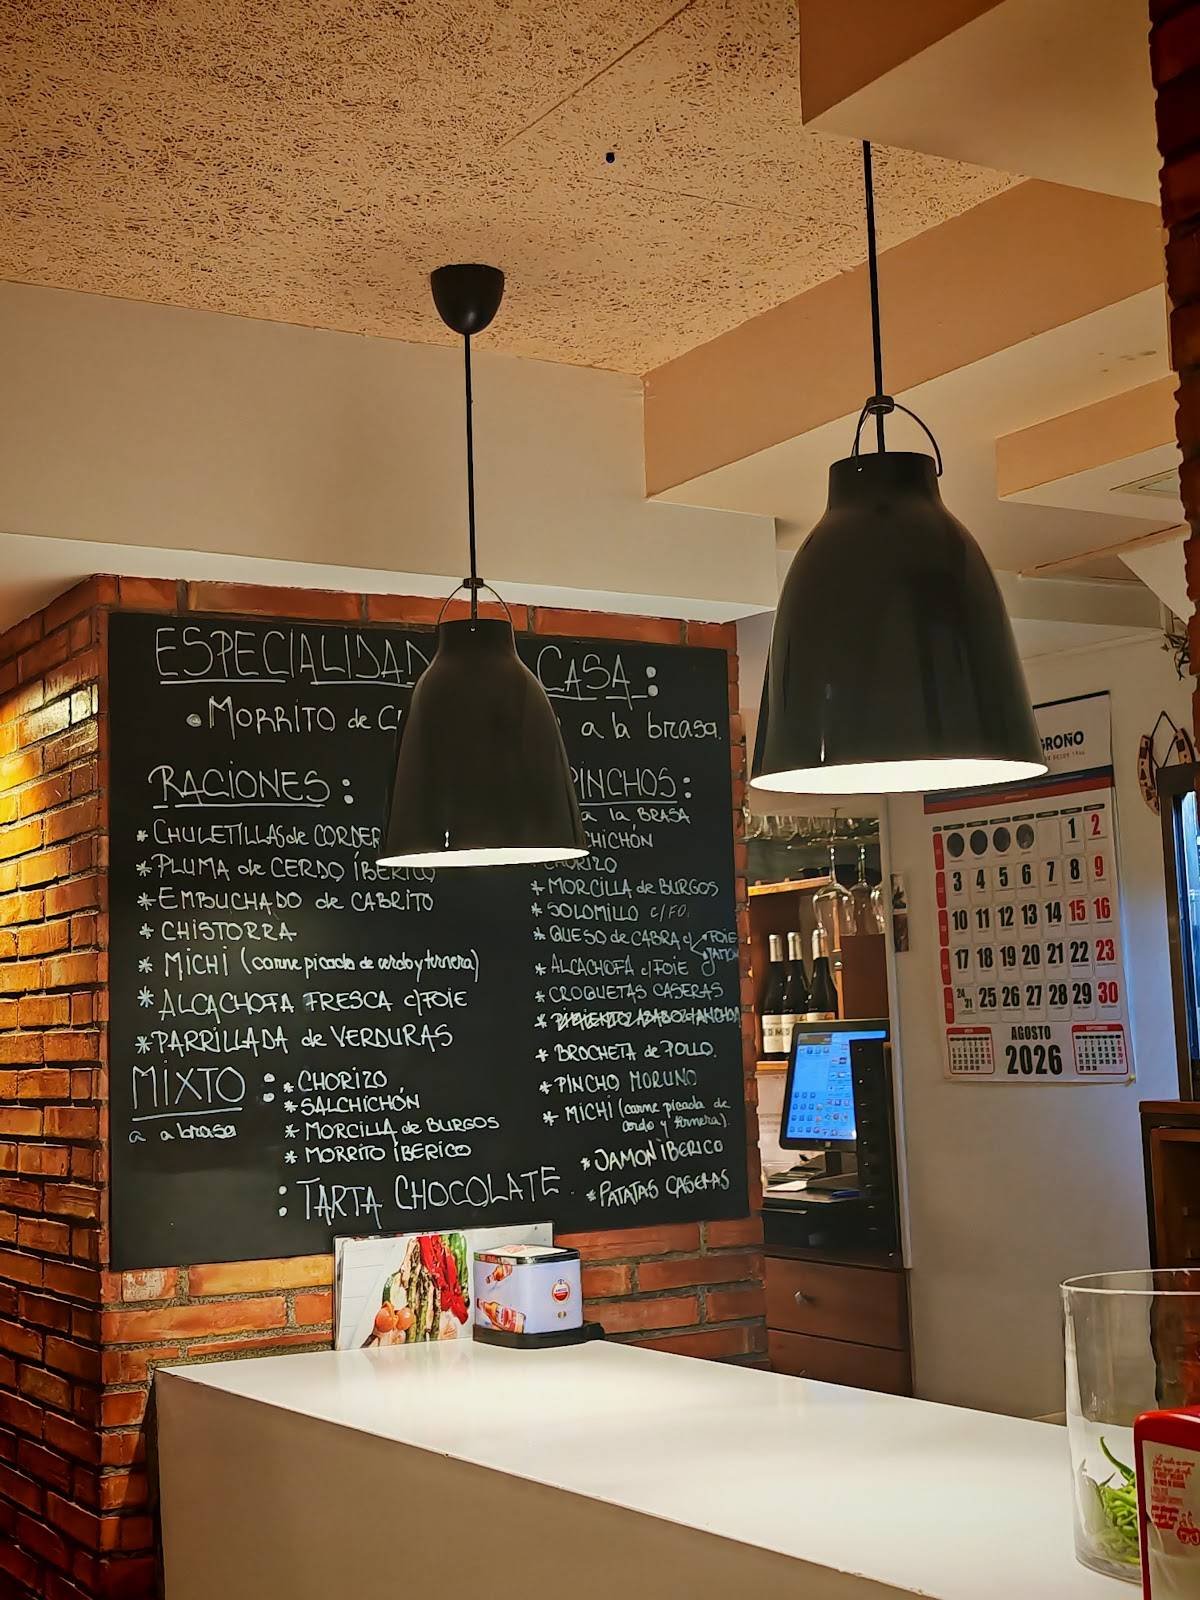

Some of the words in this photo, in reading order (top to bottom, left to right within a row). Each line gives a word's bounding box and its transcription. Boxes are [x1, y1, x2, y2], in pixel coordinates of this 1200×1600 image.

[209, 696, 336, 740] MORRITO
[348, 711, 371, 730] de
[582, 721, 605, 739] a
[612, 712, 631, 740] la
[581, 811, 597, 822] a
[609, 808, 631, 822] la
[637, 807, 691, 825] BRASA
[1068, 818, 1076, 839] 1
[1091, 814, 1100, 836] 2
[285, 825, 309, 846] de
[313, 826, 381, 850] CORDER
[151, 853, 232, 882] PLUMA
[238, 862, 266, 876] de
[271, 857, 345, 882] CERDO
[953, 871, 962, 892] 3
[976, 869, 986, 890] 4
[999, 866, 1009, 887] 5
[1021, 864, 1032, 885] 6
[1046, 861, 1055, 882] 7
[1070, 858, 1080, 880] 8
[1094, 855, 1104, 877] 9
[158, 886, 303, 915] EMBUCHADO
[315, 896, 345, 910] de
[351, 888, 435, 912] CABRITO
[547, 876, 633, 899] MORCILLA
[636, 880, 657, 895] de
[659, 878, 719, 897] BURGOS
[547, 902, 640, 923] SOLOMILLO
[952, 909, 968, 931] 10
[976, 908, 990, 929] 11
[998, 906, 1014, 927] 12
[1022, 903, 1038, 925] 13
[1045, 901, 1062, 923] 14
[1069, 900, 1086, 922] 15
[1094, 897, 1111, 919] 16
[162, 918, 297, 943] CHISTORRA
[550, 924, 608, 946] QUESO
[610, 929, 628, 944] de
[630, 928, 682, 951] CABRA
[164, 946, 230, 982] MICHI
[240, 946, 302, 974] (carne
[358, 956, 375, 970] de
[550, 953, 636, 976] ALCACHOFA
[955, 949, 969, 970] 17
[977, 948, 993, 969] 18
[1000, 946, 1016, 967] 19
[1022, 944, 1040, 966] 20
[1047, 942, 1064, 964] 21
[1070, 941, 1089, 963] 22
[1096, 939, 1115, 962] 23
[548, 983, 648, 1004] CROQUETAS
[652, 981, 724, 999] CASERAS
[979, 987, 997, 1008] 25
[1002, 986, 1020, 1007] 26
[1026, 985, 1043, 1006] 27
[1049, 983, 1068, 1005] 28
[1072, 982, 1092, 1005] 29
[1098, 981, 1119, 1004] 30
[158, 989, 295, 1024] ALCACHOFA
[303, 990, 394, 1013] FRESCA
[152, 1026, 289, 1057] PARRILLADA
[301, 1031, 328, 1048] de
[329, 1024, 454, 1052] VERDURAS
[1011, 1025, 1051, 1041] AGOSTO
[553, 1042, 637, 1062] BROCHETA
[643, 1046, 662, 1058] de
[1005, 1044, 1063, 1075] 2026
[297, 1067, 388, 1093] CHORIZO
[554, 1072, 620, 1094] PINCHO
[629, 1066, 698, 1092] MORUNO
[300, 1086, 421, 1117] SALCHICHÓN
[564, 1094, 614, 1124] MICHI
[662, 1094, 706, 1119] picada
[713, 1097, 732, 1109] de
[176, 1121, 238, 1141] brasa
[305, 1118, 398, 1147] MORCILLA
[401, 1122, 422, 1136] de
[426, 1116, 501, 1133] BURGOS
[660, 1120, 670, 1139] y
[305, 1144, 386, 1165] MORRITO
[297, 1178, 382, 1230] TARTA
[395, 1165, 561, 1213] CHOCOLATE
[600, 1180, 659, 1207] PATATAS
[665, 1169, 730, 1198] CASERAS
